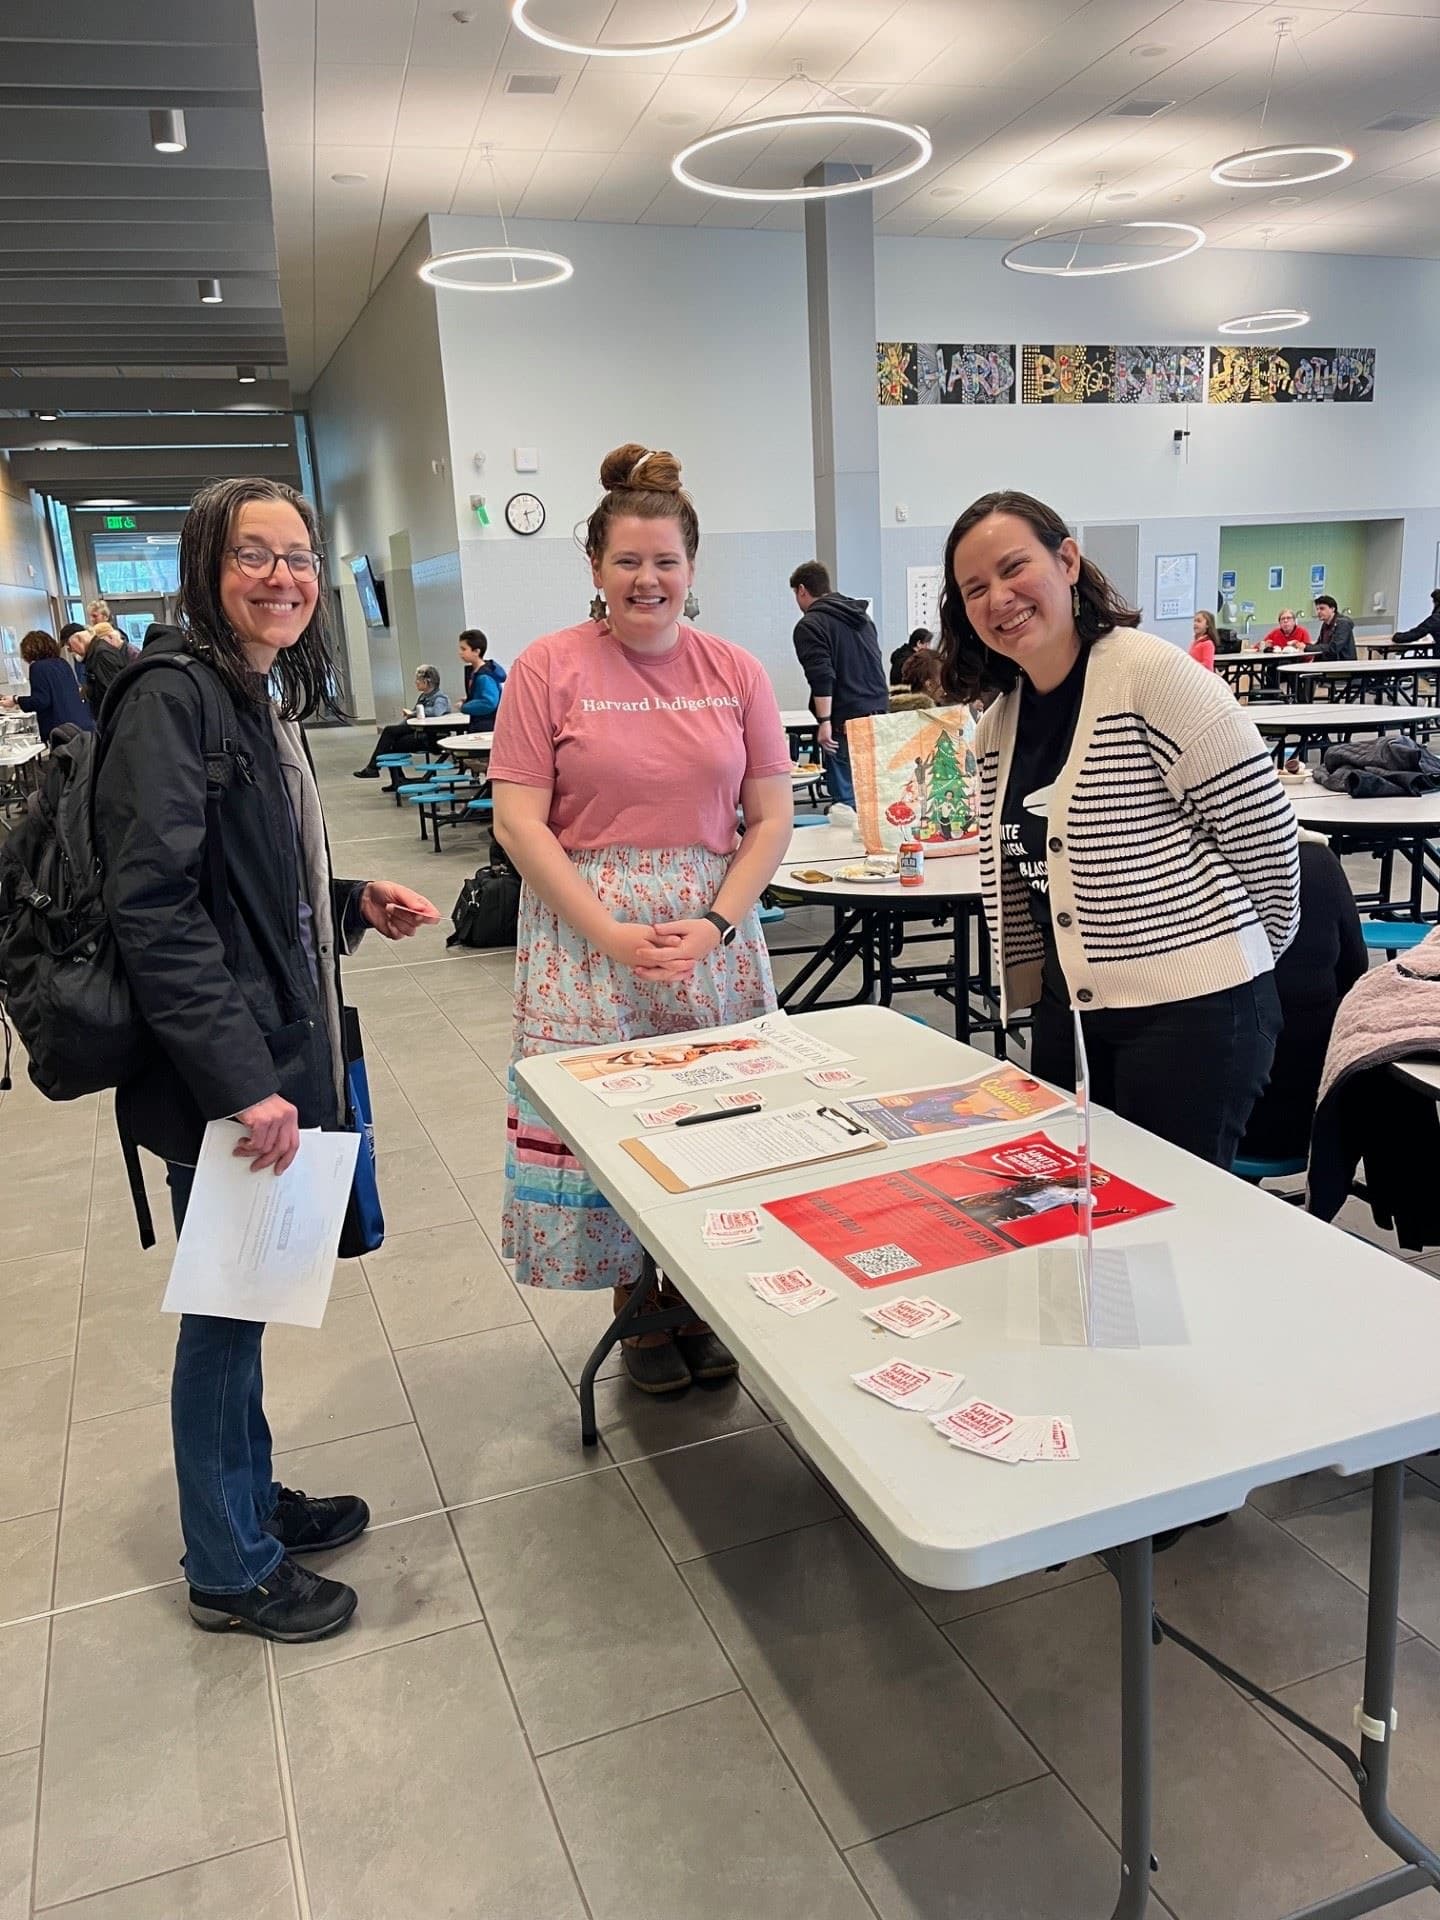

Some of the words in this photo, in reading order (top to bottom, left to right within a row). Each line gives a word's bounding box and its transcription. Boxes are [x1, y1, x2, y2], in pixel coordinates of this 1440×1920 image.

[919, 348, 1015, 396] HARD
[1115, 354, 1201, 396] KIND
[1294, 354, 1374, 397] OTHERS
[581, 698, 651, 712] Harvard
[1000, 824, 1021, 840] ITE
[921, 1201, 972, 1231] ACTIVIST
[962, 1230, 1006, 1254] OPERA
[890, 1366, 924, 1384] WHITE
[961, 1411, 999, 1431] SNAKE
[970, 1406, 1006, 1427] WHITE
